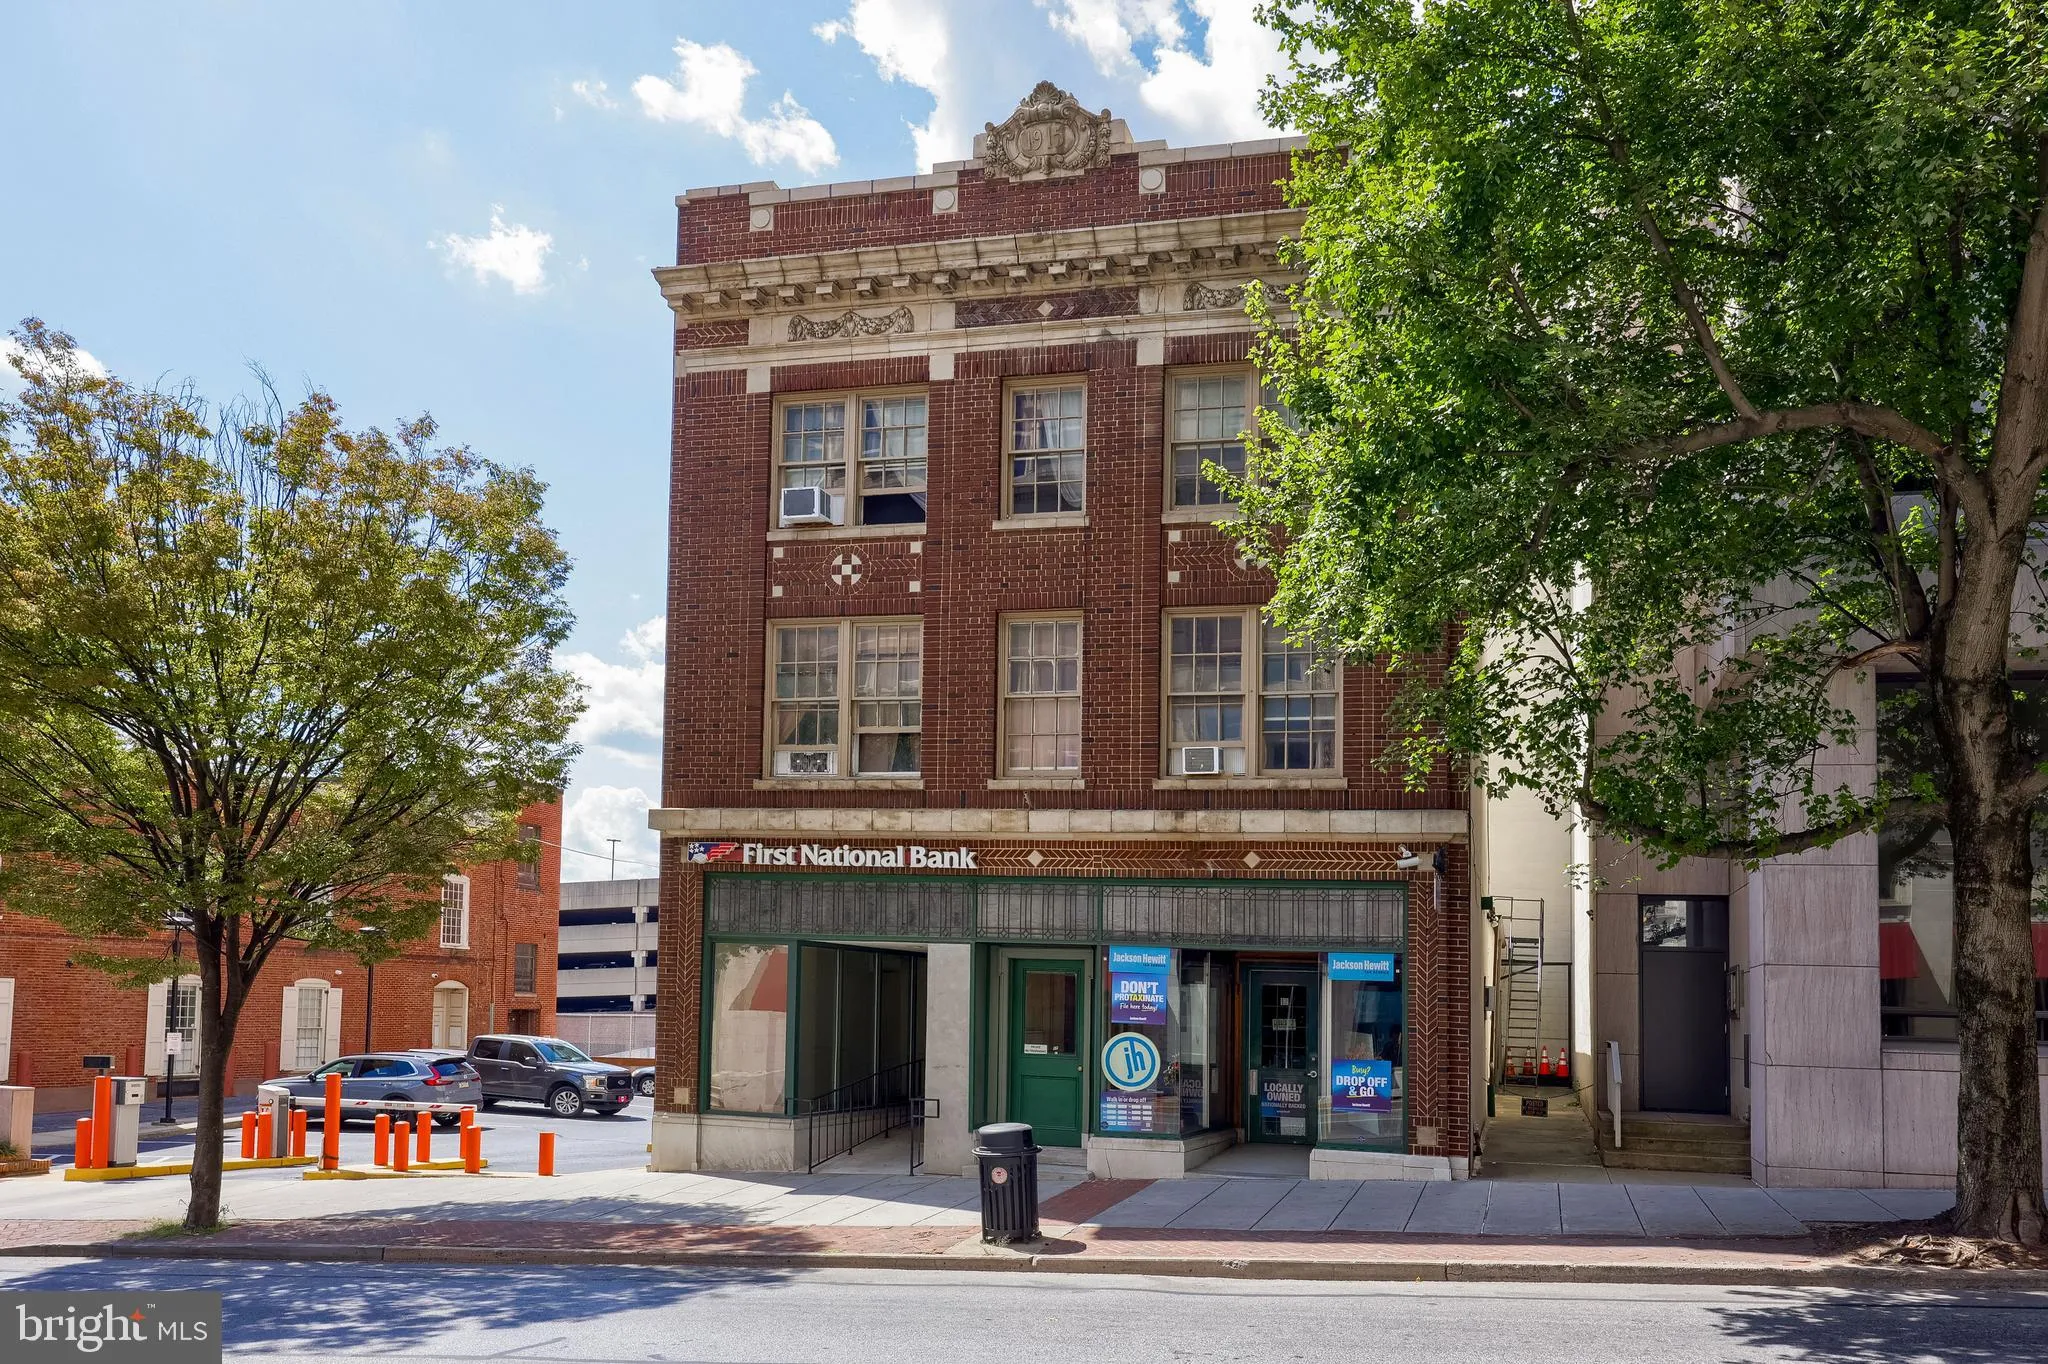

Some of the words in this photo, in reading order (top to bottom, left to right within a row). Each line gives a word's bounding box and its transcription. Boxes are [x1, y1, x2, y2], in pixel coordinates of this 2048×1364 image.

[1025, 123, 1065, 151] 1915
[742, 843, 796, 865] First
[800, 844, 905, 868] National
[910, 846, 978, 869] Bank
[1113, 952, 1142, 963] Jackson
[1143, 954, 1166, 964] Hewitt
[1333, 960, 1363, 970] Jackson
[1364, 960, 1390, 970] Hewitt
[1121, 980, 1159, 994] DON'T
[1114, 993, 1164, 1003] PROTAXINATE
[1120, 1002, 1128, 1010] File
[1141, 1004, 1158, 1013] today!
[1123, 1040, 1146, 1079] jh
[1352, 1065, 1371, 1076] Busy?
[1336, 1076, 1365, 1086] DROP
[1367, 1077, 1388, 1087] OFF
[1264, 1082, 1304, 1093] LOCALLY
[1348, 1086, 1357, 1096] &
[1359, 1086, 1375, 1097] GO
[1266, 1092, 1301, 1102] OWNED
